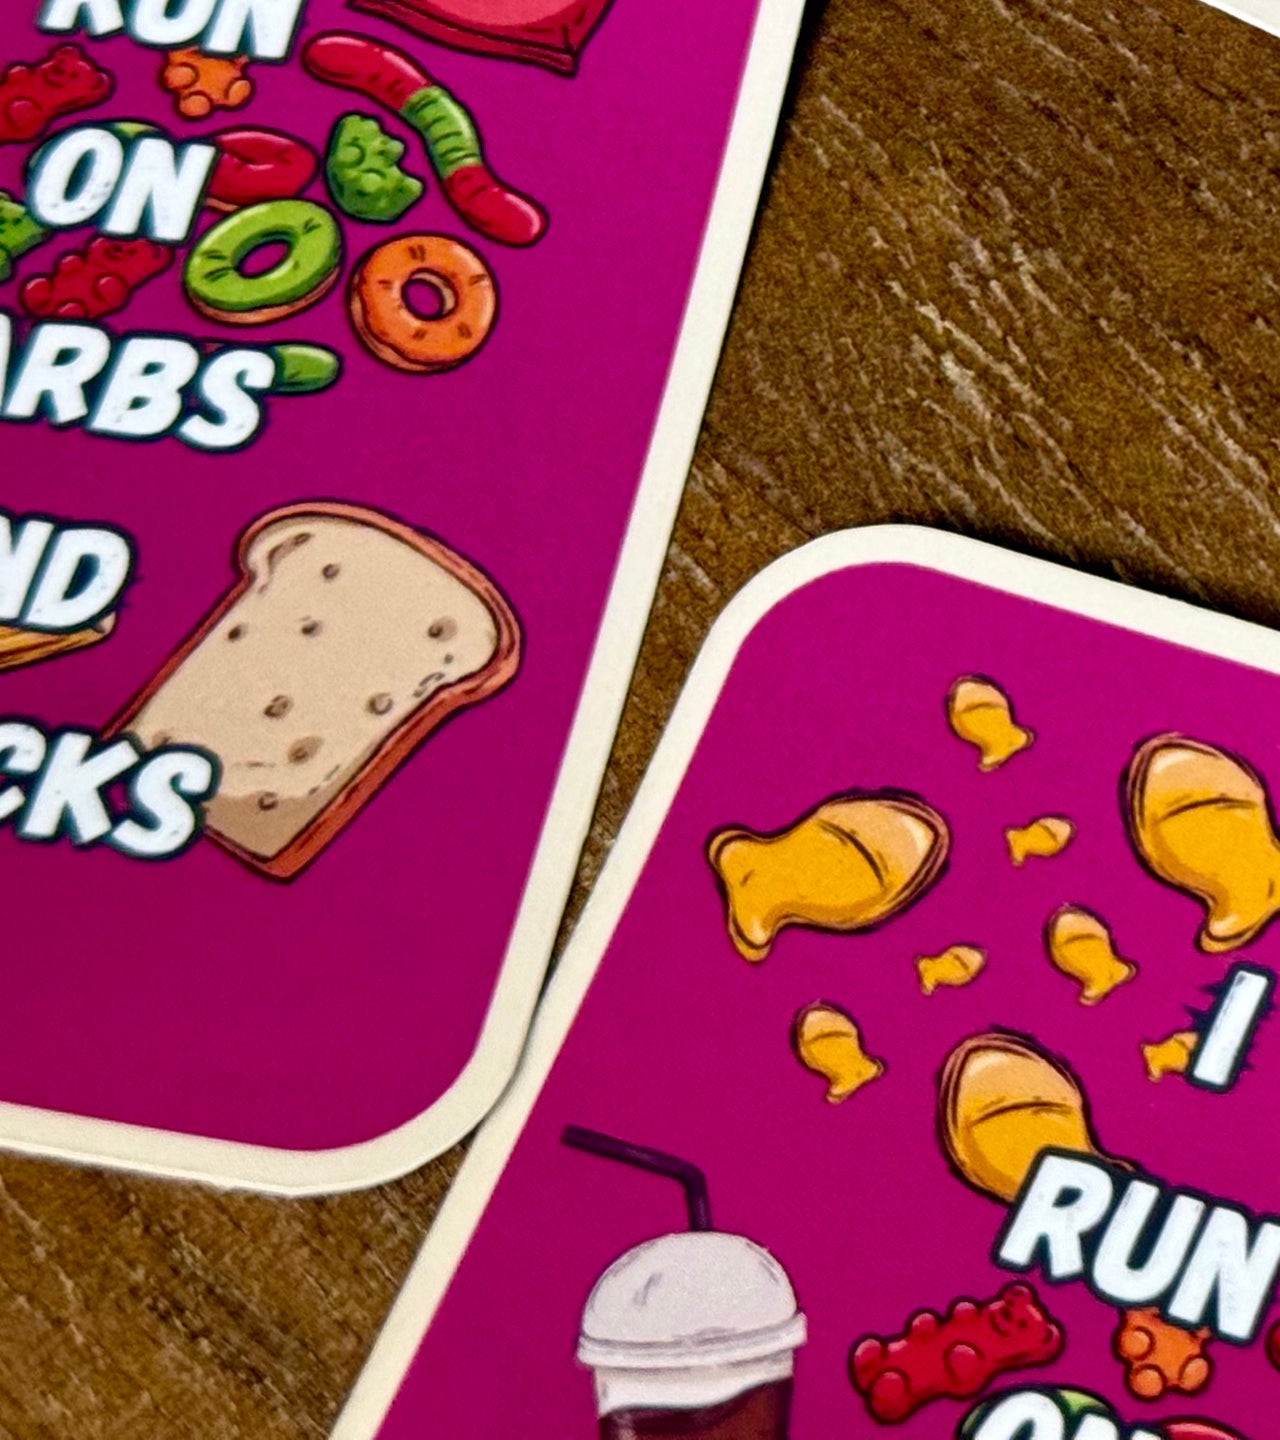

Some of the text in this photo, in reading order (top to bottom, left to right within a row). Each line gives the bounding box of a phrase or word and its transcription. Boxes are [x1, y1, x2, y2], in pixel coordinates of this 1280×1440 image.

[34, 129, 213, 239] ON
[0, 315, 272, 446] RBS
[1194, 971, 1267, 1084] I
